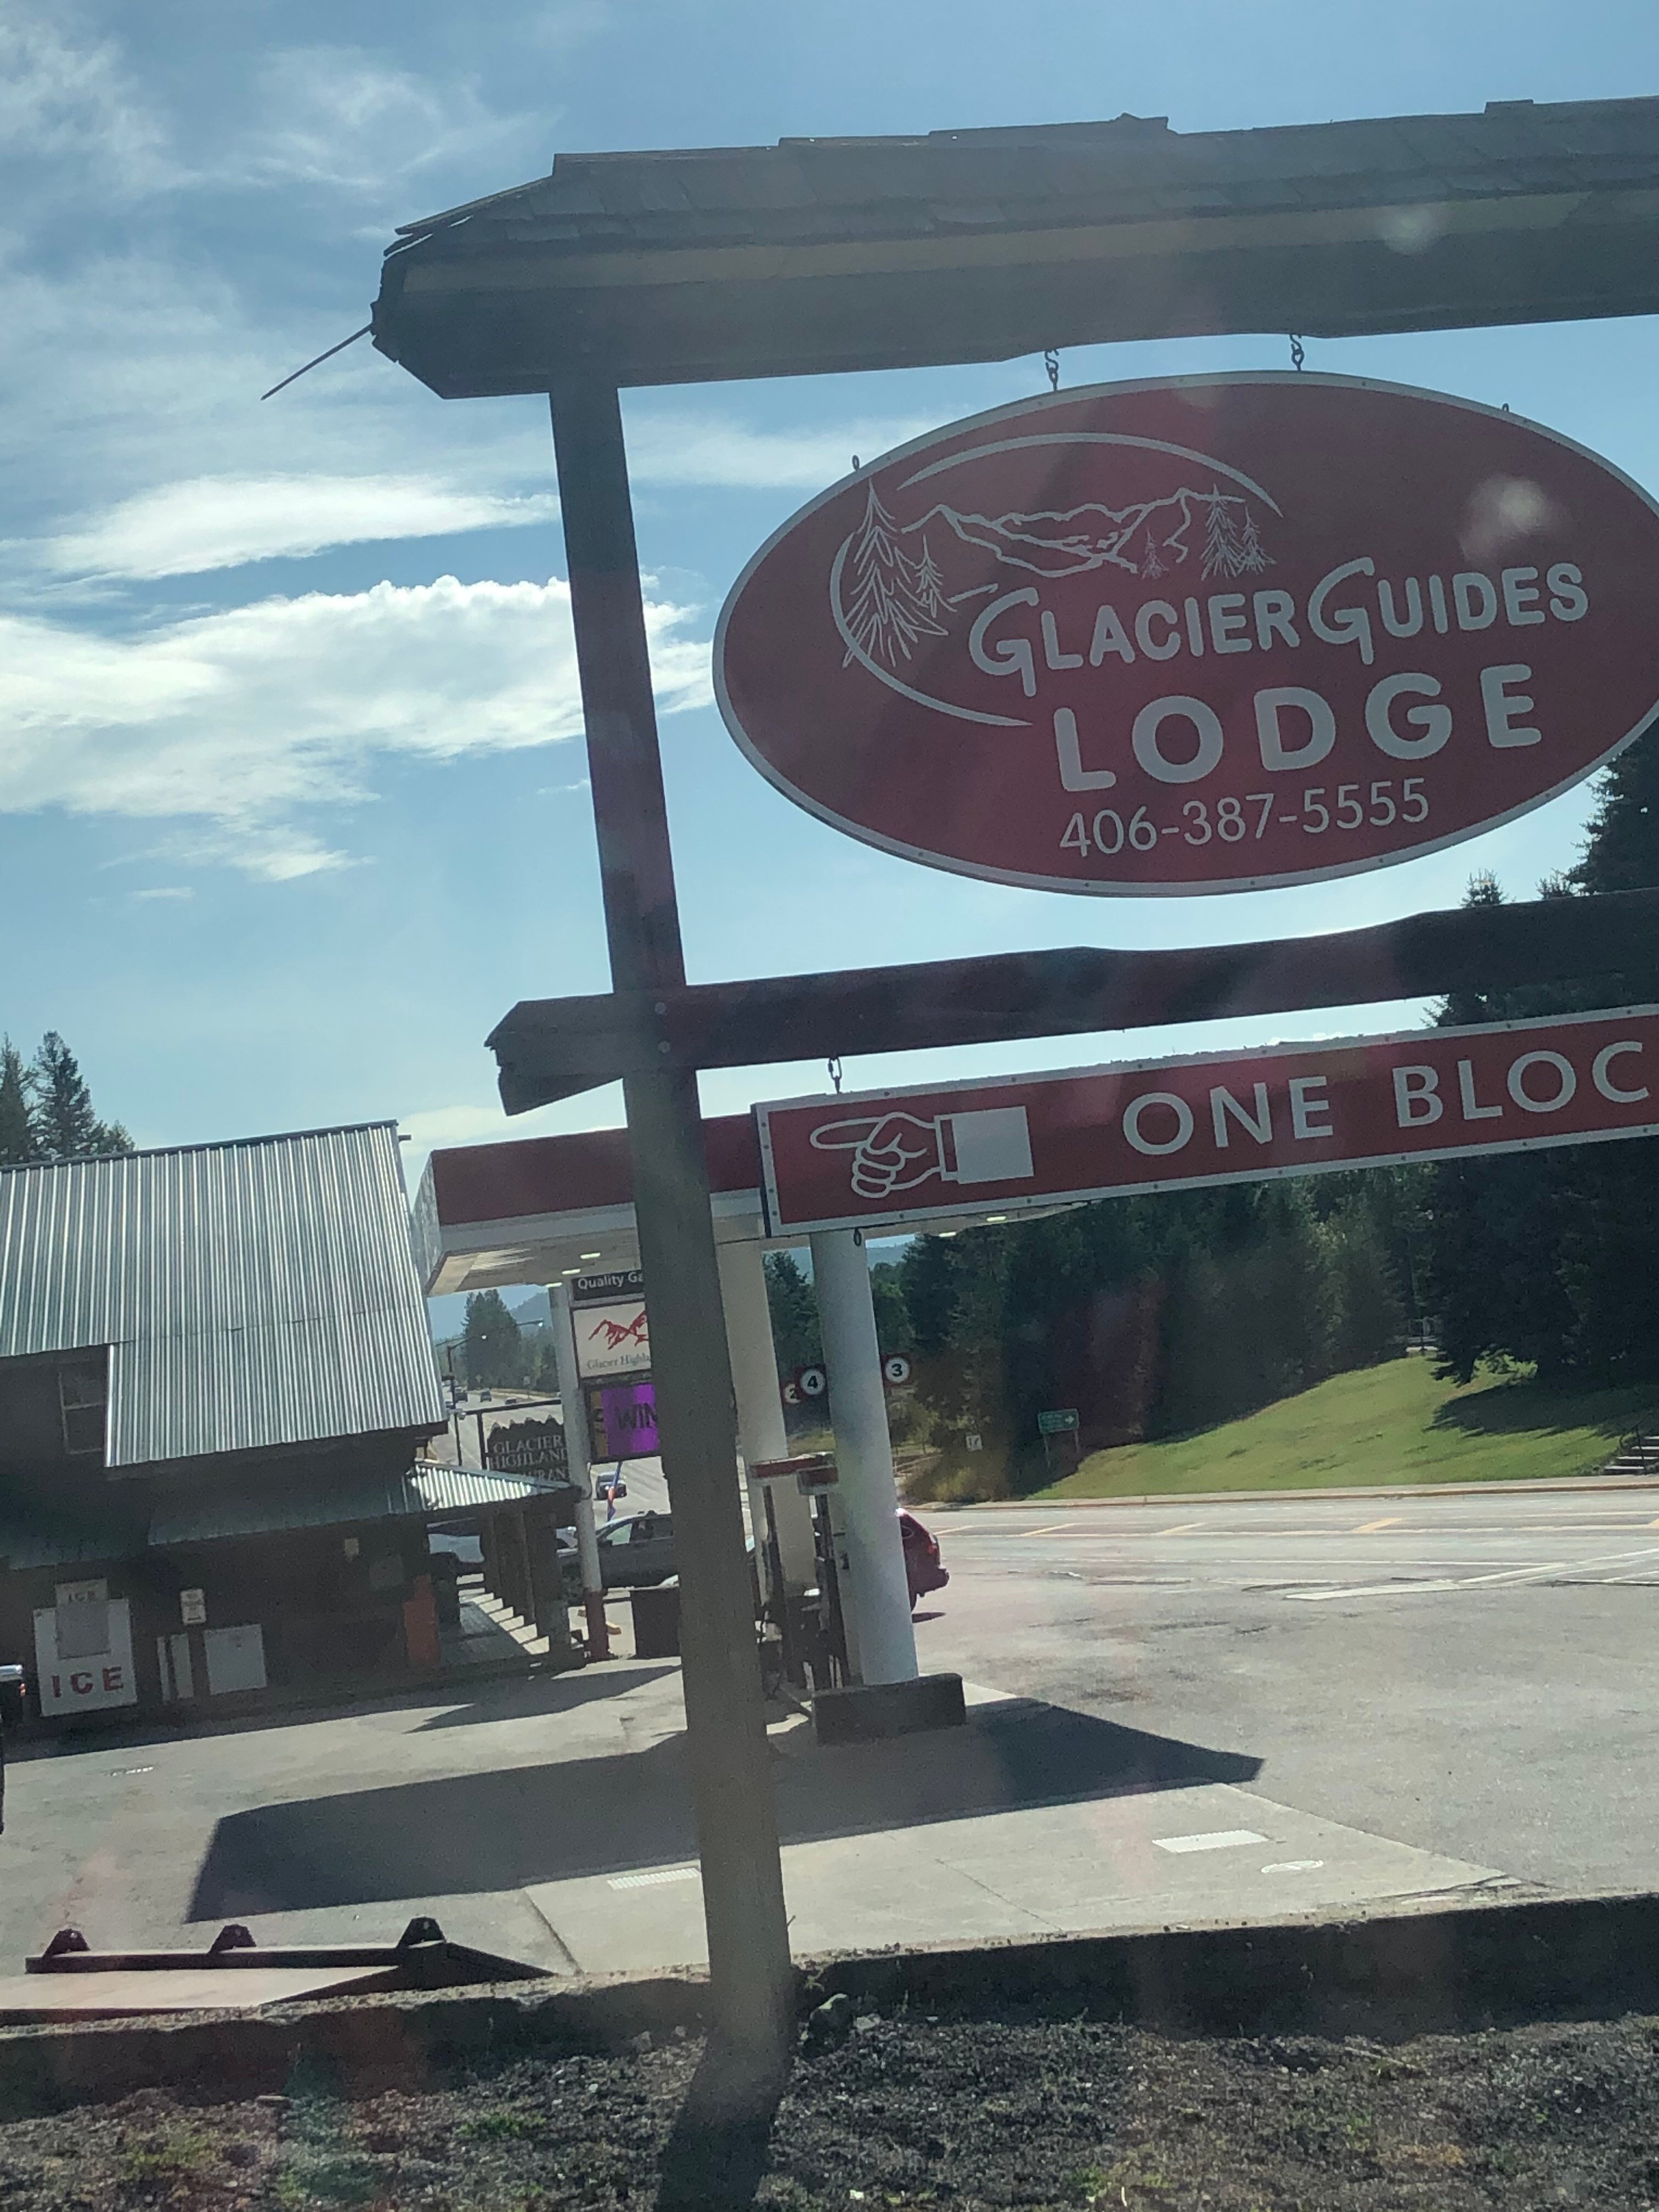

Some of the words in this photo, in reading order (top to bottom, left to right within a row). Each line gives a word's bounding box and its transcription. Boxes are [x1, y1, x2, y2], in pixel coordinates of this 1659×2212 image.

[969, 587, 1300, 697] GLACIER
[1308, 557, 1588, 665] GUIDES
[1053, 664, 1542, 792] LODGE
[1059, 778, 1429, 857] 406-387-5555
[1122, 1076, 1334, 1155] ONE
[1392, 1041, 1650, 1128] BLOC
[578, 1274, 624, 1289] Quality
[807, 1375, 819, 1389] 4
[891, 1363, 903, 1377] 3
[494, 1435, 563, 1453] GLACIER
[52, 1666, 123, 1698] ICE
